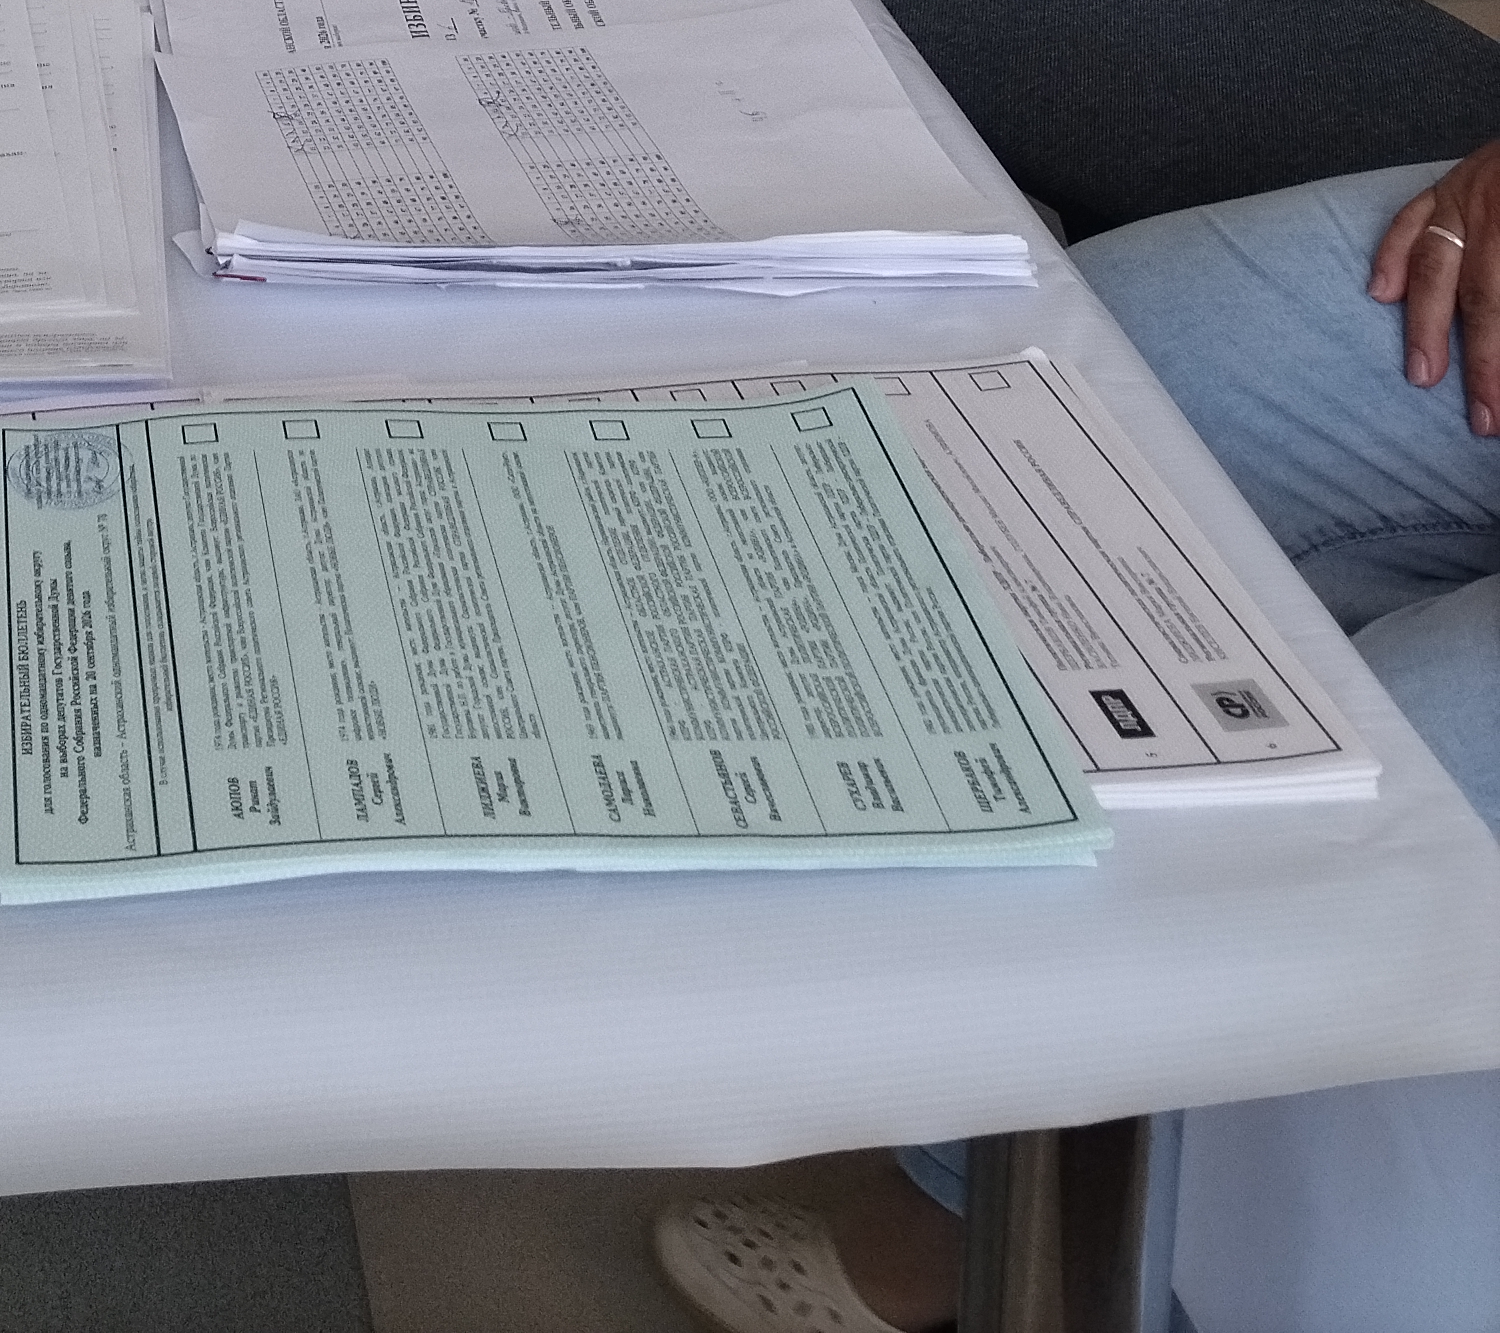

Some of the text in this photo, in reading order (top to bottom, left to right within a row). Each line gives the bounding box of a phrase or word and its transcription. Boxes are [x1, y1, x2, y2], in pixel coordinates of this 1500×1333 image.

[15, 599, 33, 755] ИЗБИРАТЕЛЬНЫЙ БЮЛЛЕТЕНЬ
[226, 776, 244, 819] АЮПОВ
[835, 760, 868, 811] СУХАРЕВ
